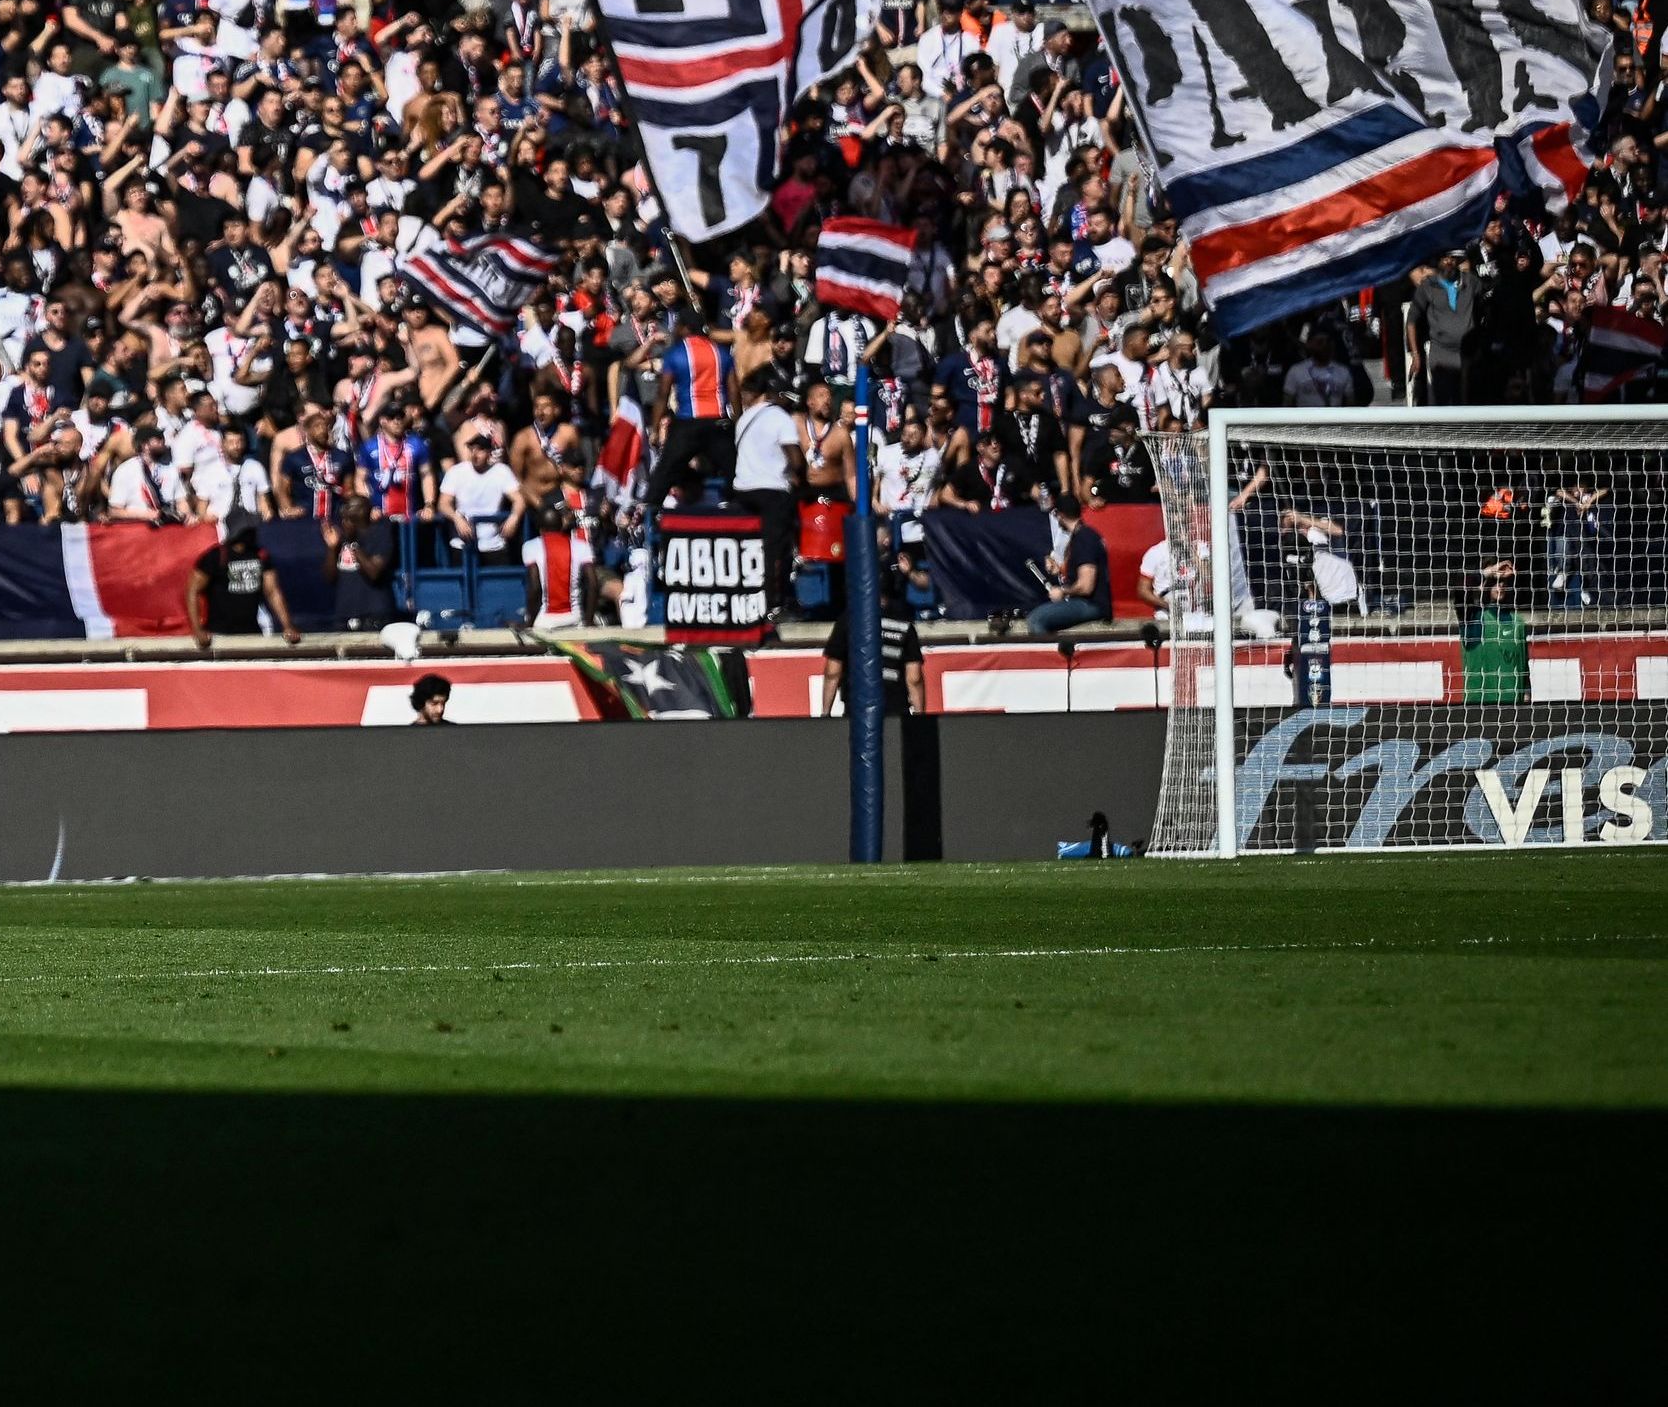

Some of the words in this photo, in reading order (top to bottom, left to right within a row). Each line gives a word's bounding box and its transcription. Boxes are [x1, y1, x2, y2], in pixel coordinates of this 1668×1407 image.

[673, 134, 728, 229] 7
[666, 592, 728, 625] AVEC
[1207, 706, 1668, 853] fre
[1474, 765, 1654, 845] VIS
